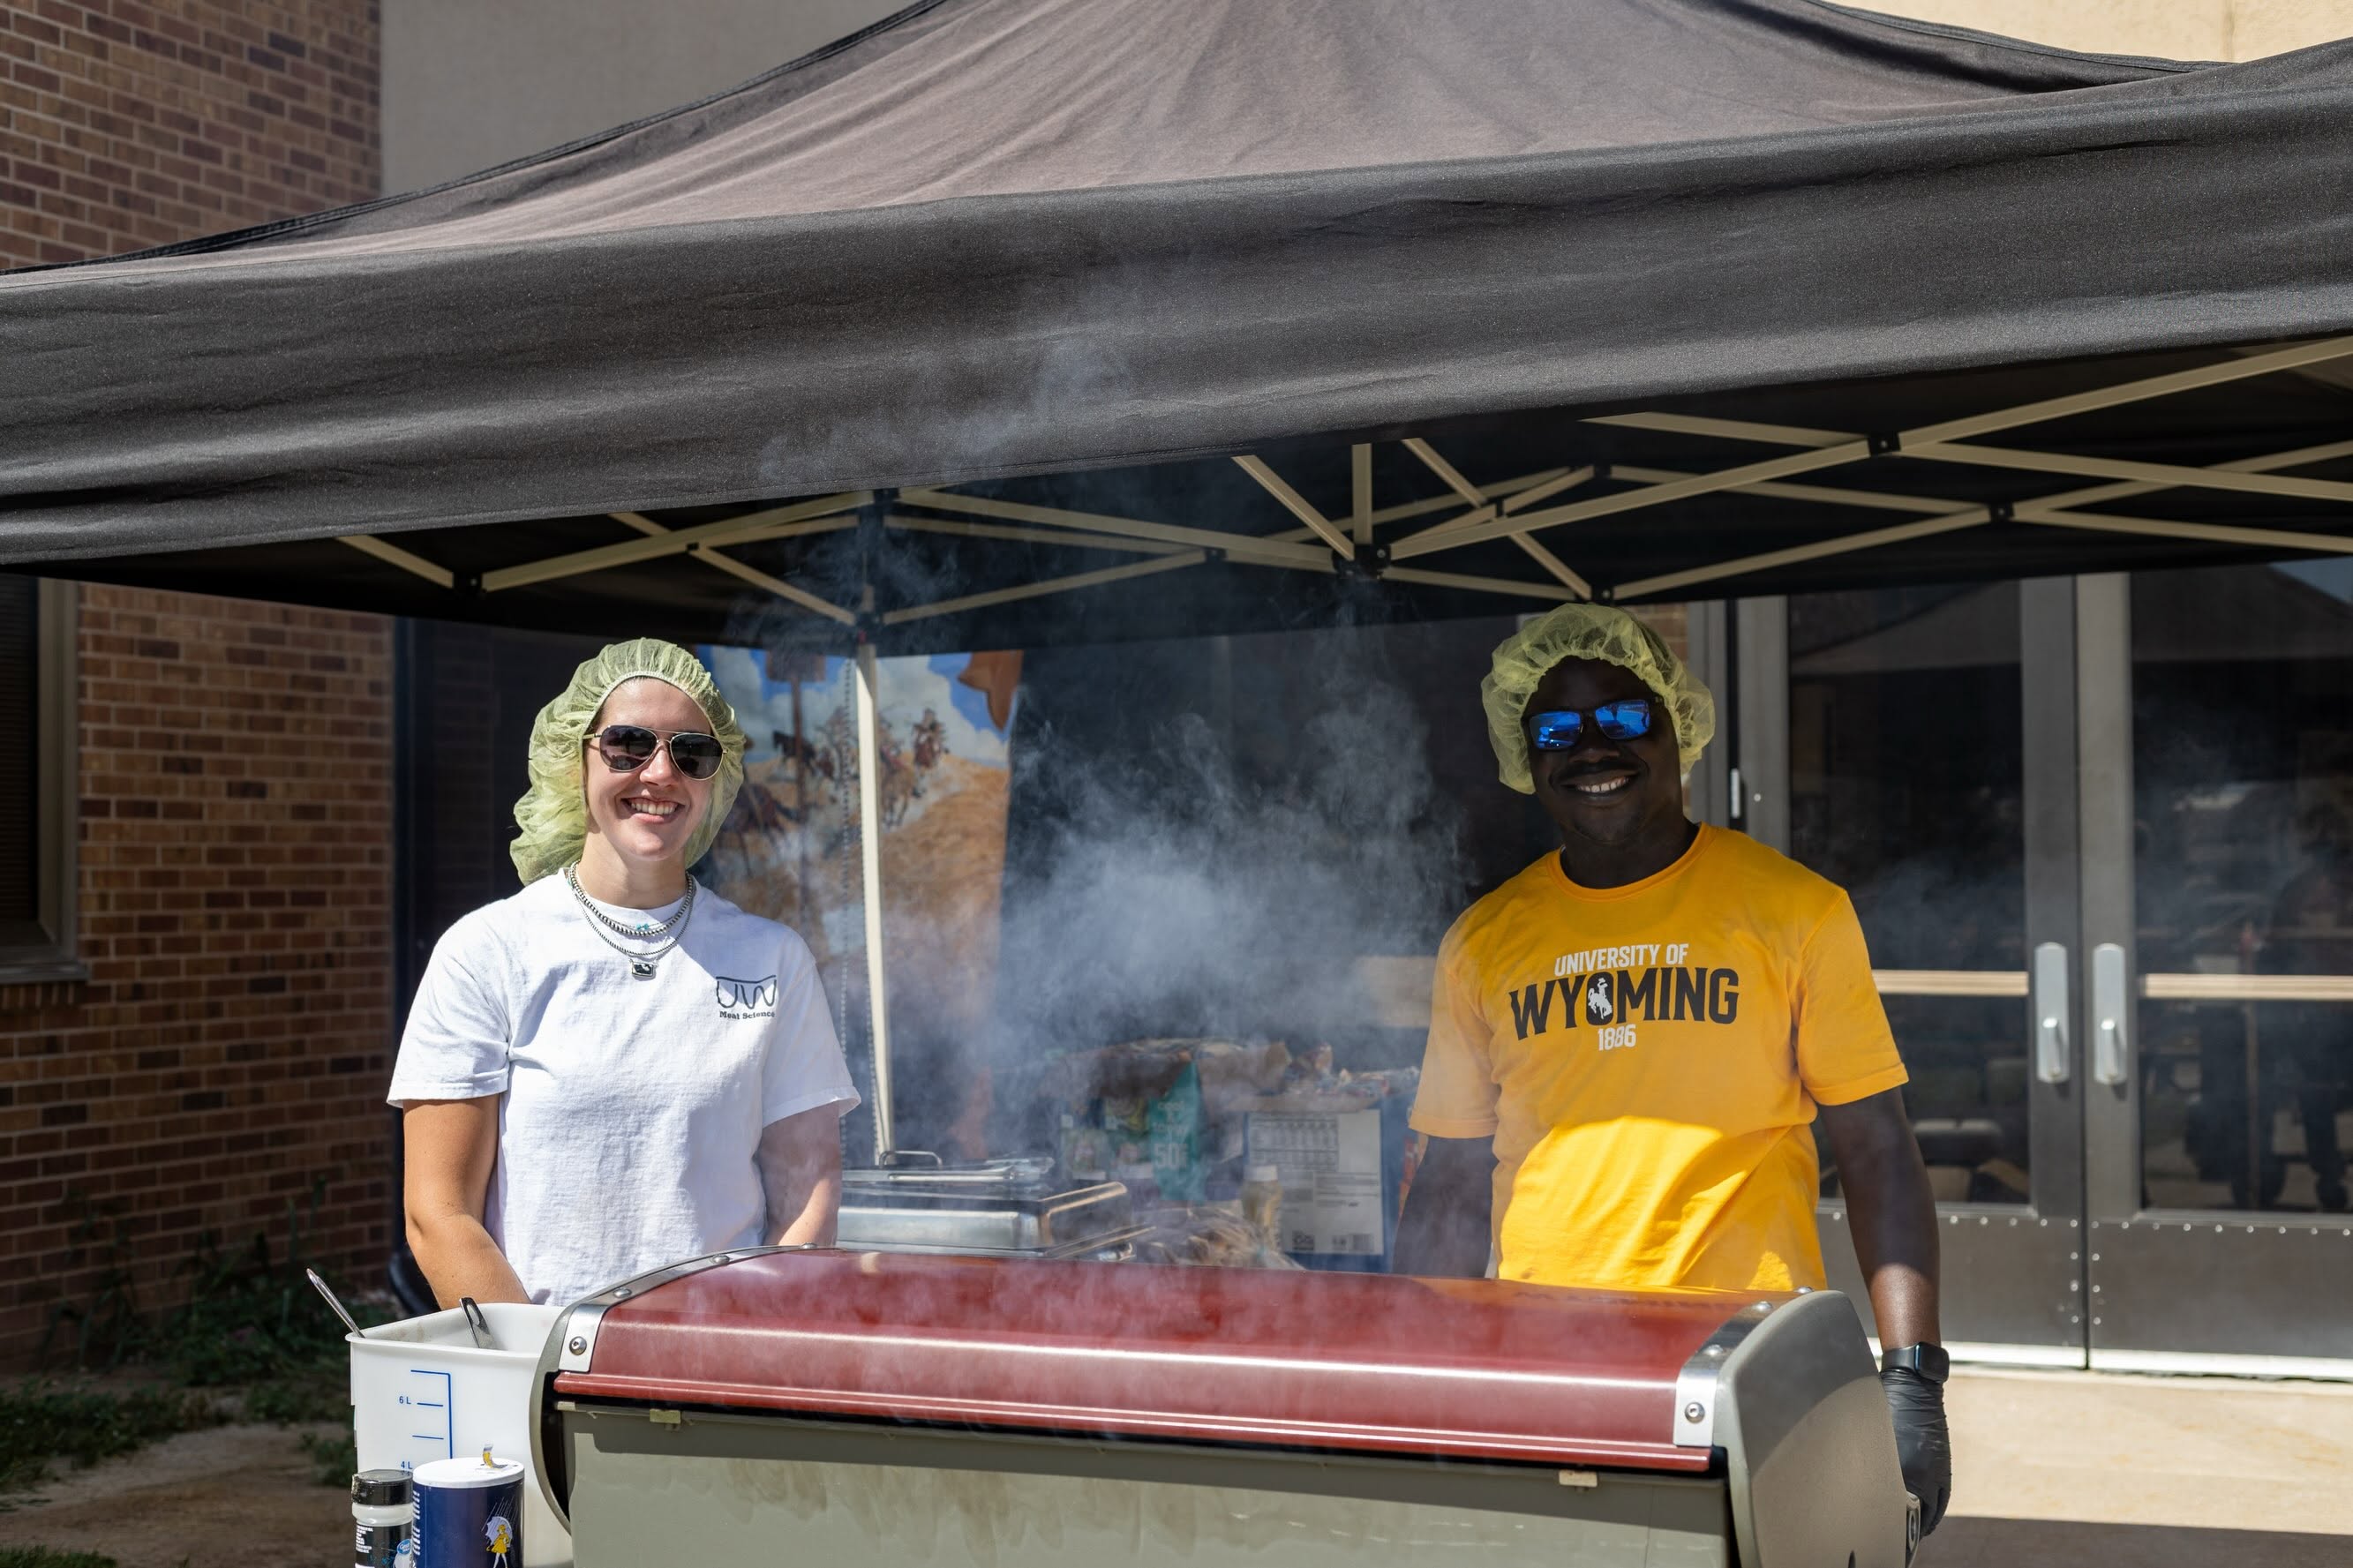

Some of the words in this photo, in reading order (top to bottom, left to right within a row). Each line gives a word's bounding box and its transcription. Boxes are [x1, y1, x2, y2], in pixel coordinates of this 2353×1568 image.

[1554, 944, 1661, 977] UNIVERSITY
[1665, 943, 1689, 965] OF
[719, 1010, 740, 1020] Meat
[742, 1011, 776, 1020] Science
[1508, 967, 1740, 1041] WYOMING
[1597, 1024, 1637, 1051] 1886
